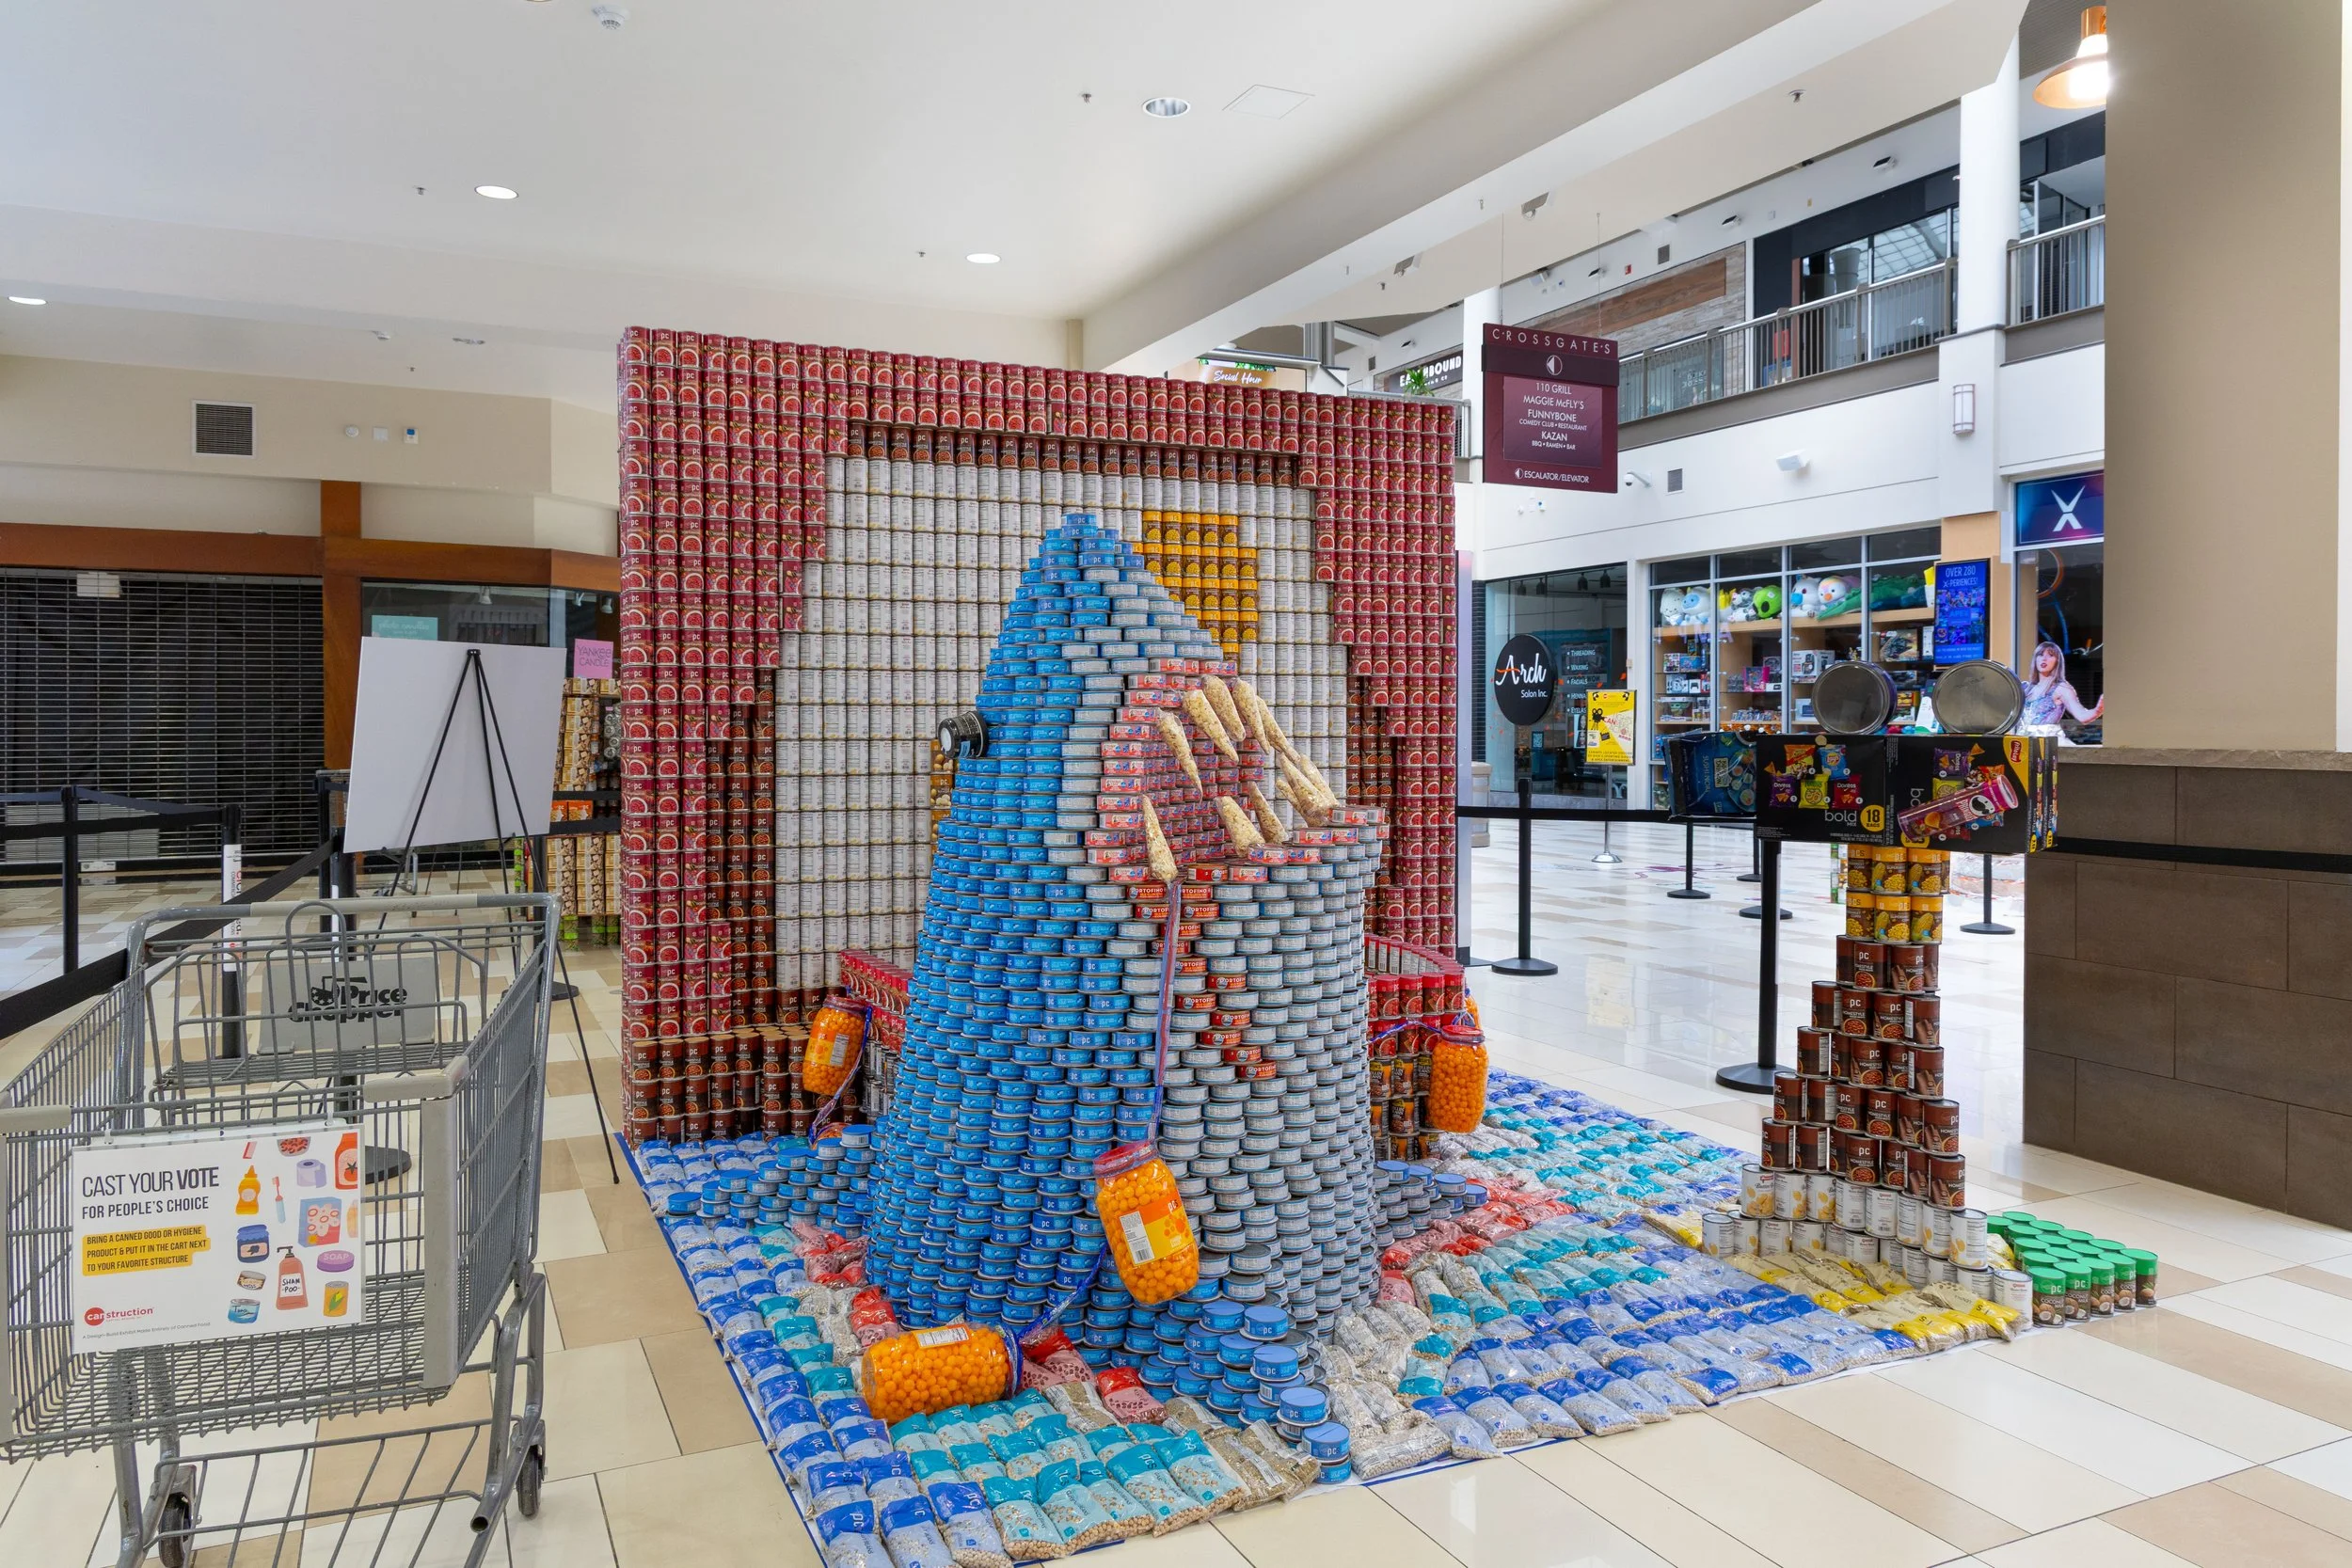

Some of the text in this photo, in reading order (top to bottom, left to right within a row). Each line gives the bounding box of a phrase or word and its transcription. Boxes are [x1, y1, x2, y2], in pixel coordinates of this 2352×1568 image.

[1492, 328, 1611, 354] CROSSGATES
[1242, 371, 1262, 385] Hour
[1535, 383, 1571, 395] 110 GRILL
[1523, 395, 1584, 410] MAGGIE McFLY'S
[1527, 409, 1577, 422] FUNNYBONE
[1558, 422, 1587, 431] RESTAURANT
[1541, 431, 1567, 441] KAZAN
[1524, 470, 1589, 483] ESCALATOR/ELEVATOR
[1946, 565, 1976, 578] OVER 280
[580, 658, 609, 668] CANDLE
[1495, 653, 1547, 686] Arch
[1520, 689, 1548, 698] Salon Inc.
[1825, 811, 1856, 821] bold
[1866, 810, 1880, 822] 18
[82, 1166, 219, 1197] CAST YOUR VOTE
[82, 1196, 209, 1219] FOR PEOPLE'S CHOICE
[87, 1235, 107, 1244] BRING
[115, 1232, 142, 1242] CANNED
[144, 1230, 162, 1240] GOOD
[173, 1227, 201, 1236] HYGIENE
[87, 1247, 117, 1258] PRODUCT
[148, 1244, 154, 1253] IN
[157, 1243, 168, 1252] THE
[170, 1242, 187, 1251] CART
[189, 1240, 206, 1249] NEXT
[87, 1255, 188, 1272] TO YOUR FAVORITE STRUCTURE
